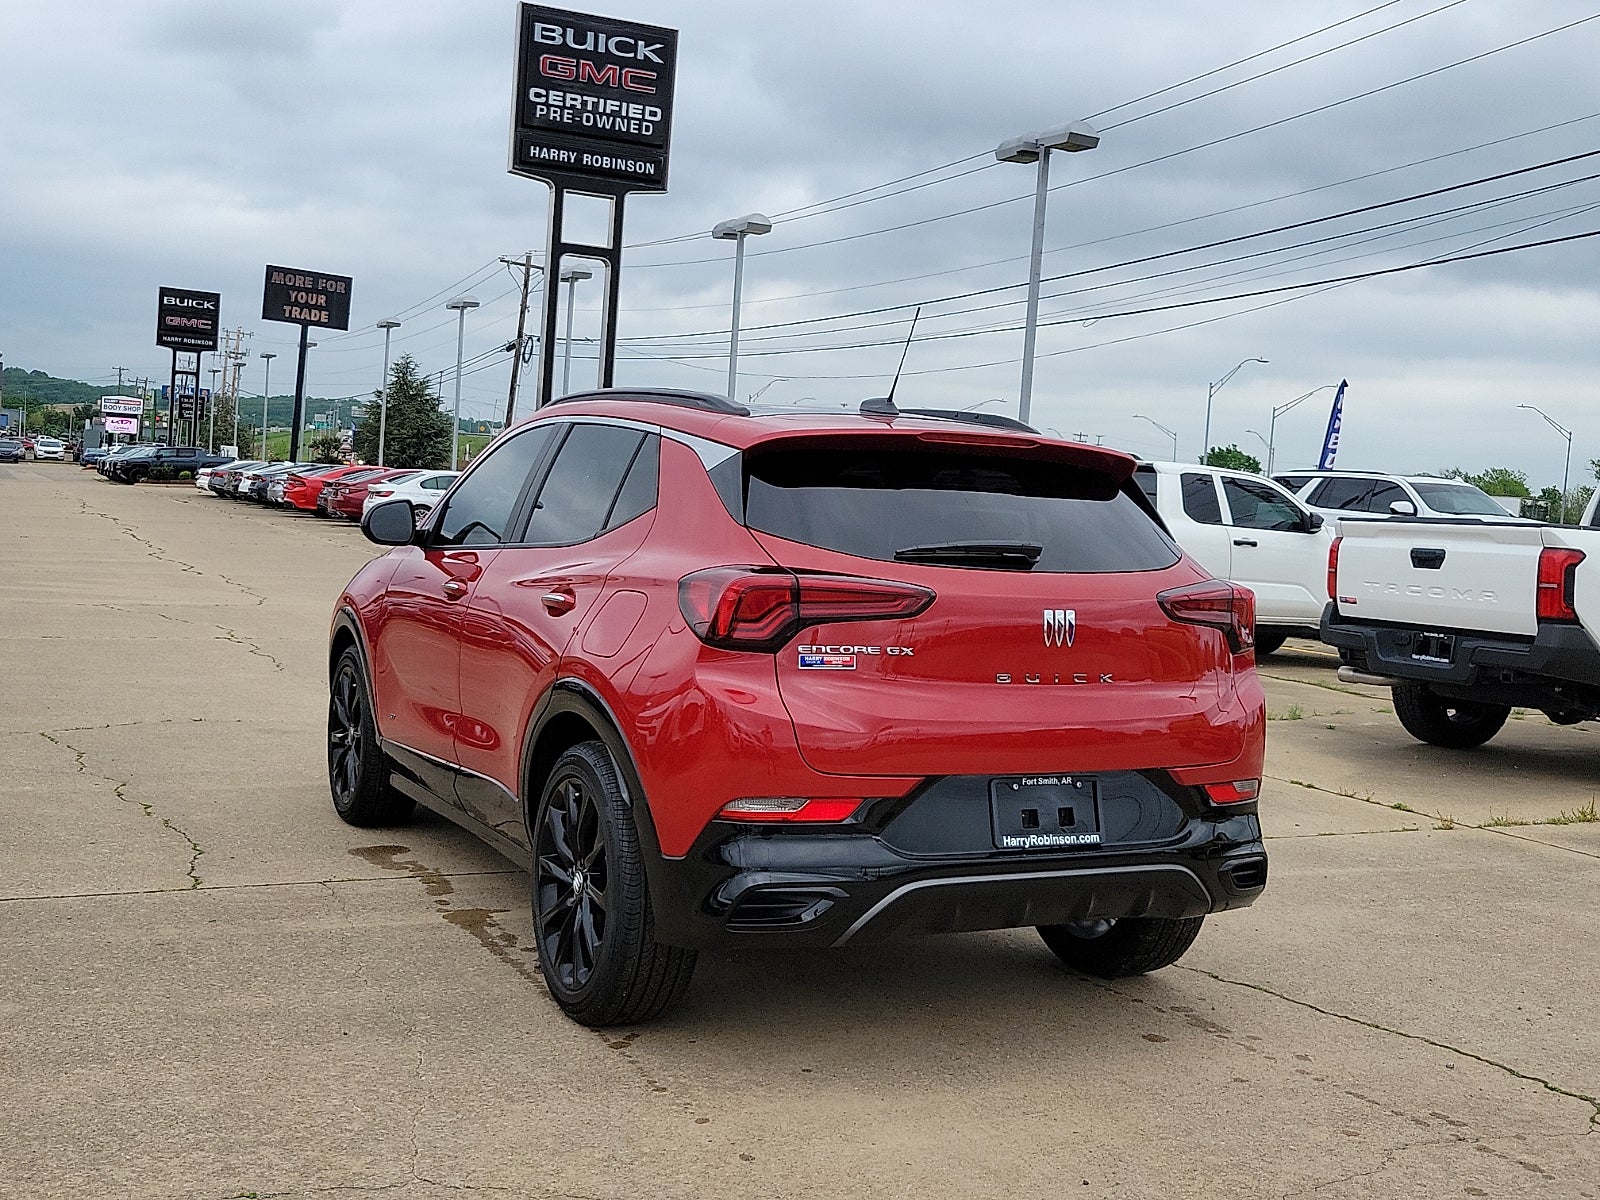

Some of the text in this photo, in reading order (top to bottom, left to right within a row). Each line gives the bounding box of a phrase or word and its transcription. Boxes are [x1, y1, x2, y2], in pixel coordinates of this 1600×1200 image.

[533, 22, 665, 64] BUICK
[540, 54, 657, 94] GMC
[529, 87, 662, 122] CERTIFIED
[535, 105, 654, 136] PRE-OWNED
[529, 145, 655, 175] HARRY ROBINSON
[271, 271, 346, 294] MORE FOR
[163, 296, 216, 310] BUICK
[289, 290, 327, 307] YOUR
[283, 305, 330, 323] TRADE
[165, 316, 213, 330] GMC
[162, 335, 214, 346] HARRY ROBINSON
[1363, 581, 1498, 603] TACOMA
[798, 645, 914, 656] ENCORE GX
[996, 673, 1114, 683] BUICK
[1022, 776, 1073, 786] Fort Smith, AR
[1002, 834, 1100, 848] HarryRobinson.com
